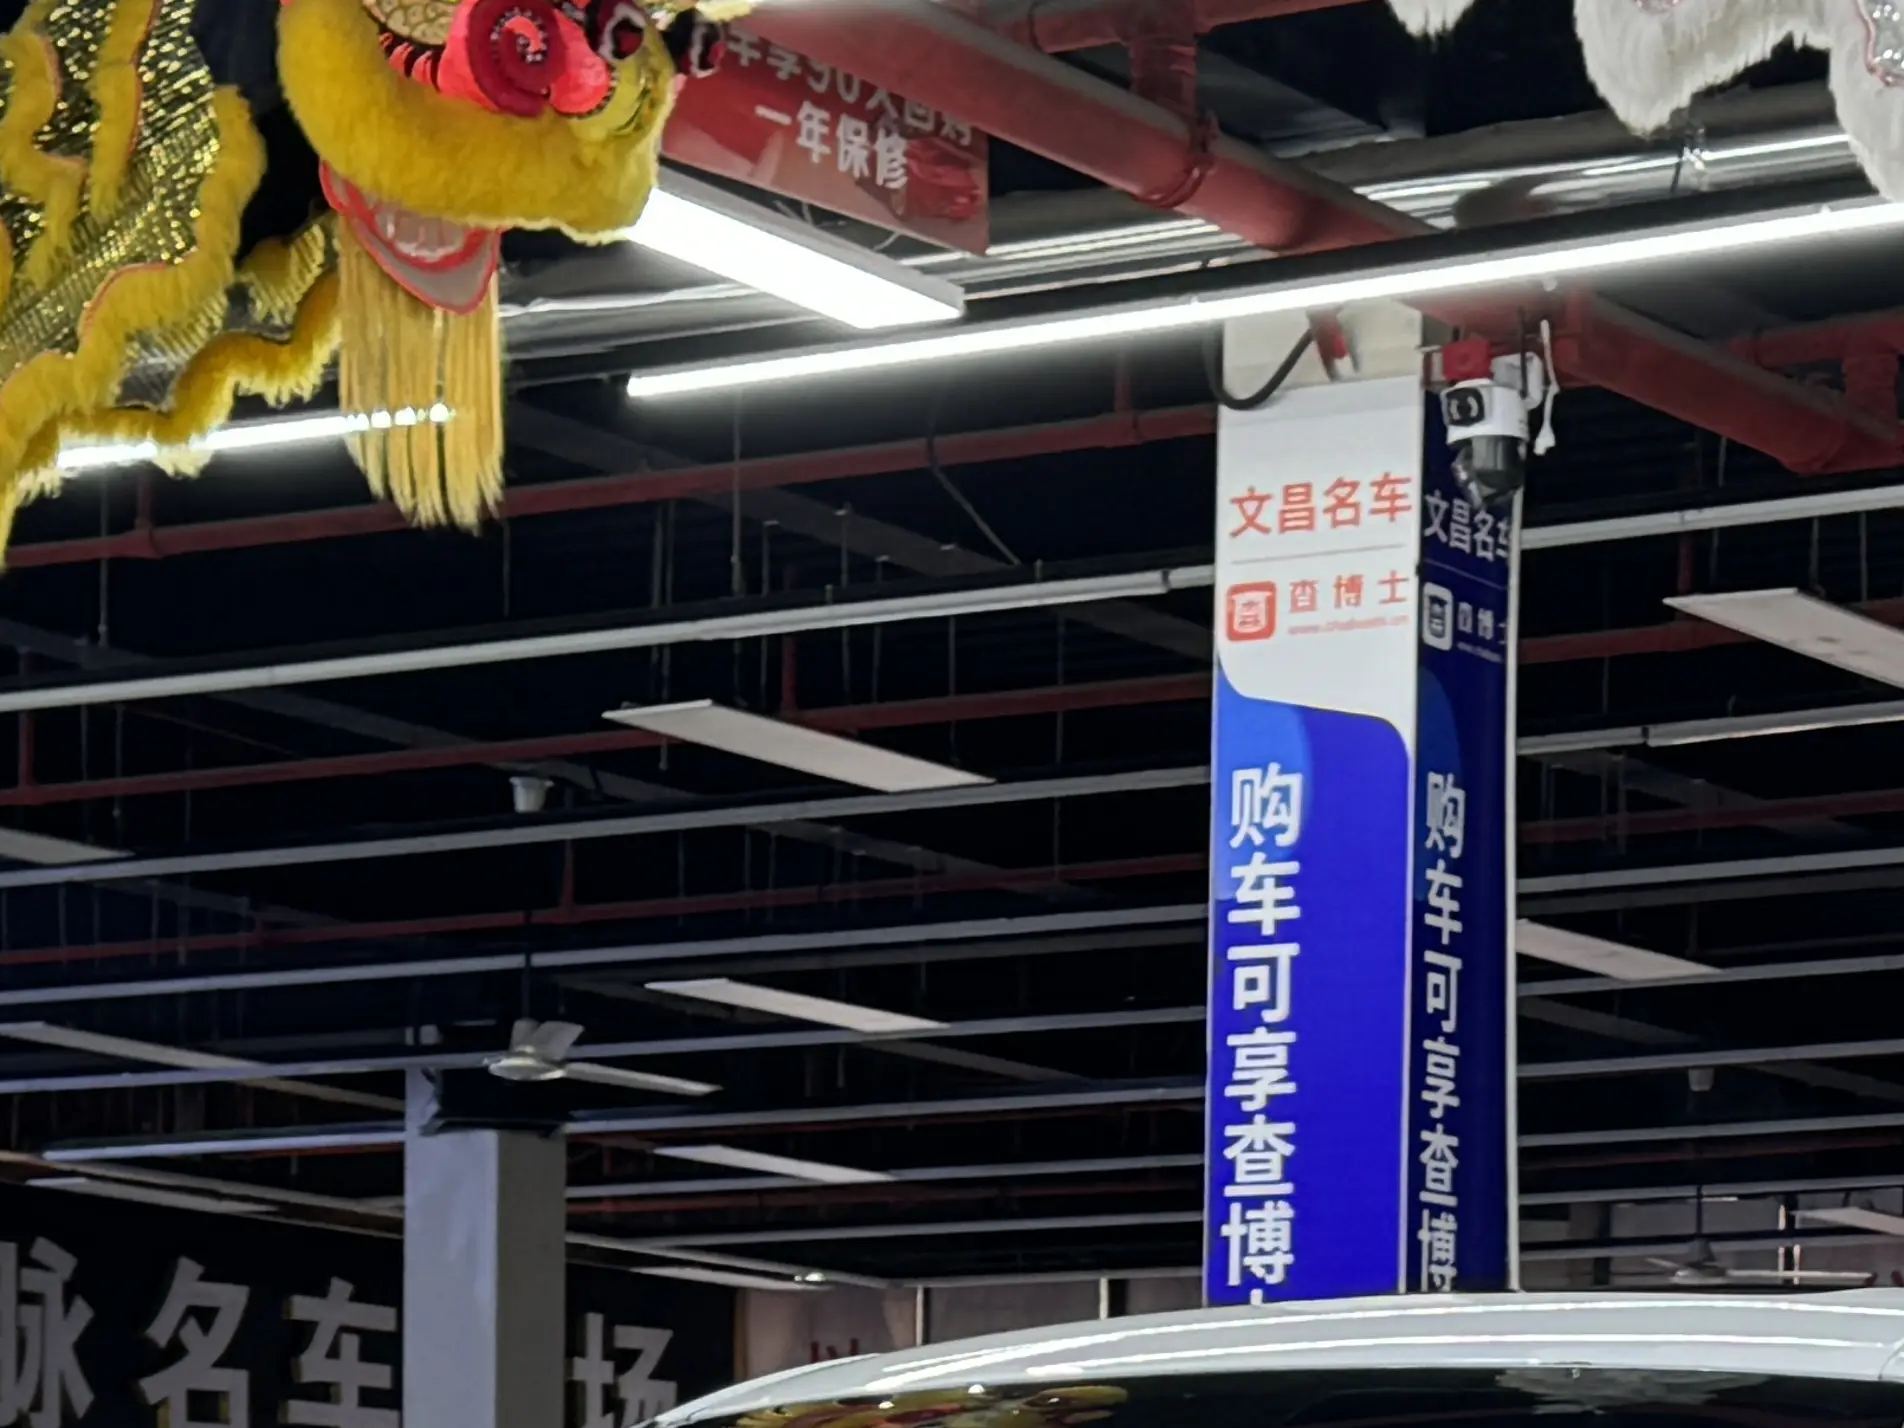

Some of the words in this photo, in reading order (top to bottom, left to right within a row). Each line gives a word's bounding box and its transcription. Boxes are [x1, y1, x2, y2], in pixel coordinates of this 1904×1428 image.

[754, 101, 908, 189] 一年保修
[1229, 472, 1413, 538] 文昌名车
[1289, 570, 1409, 613] 查博士
[1221, 762, 1303, 1306] 购车可享查博
[1418, 771, 1466, 1292] 购车可享查博
